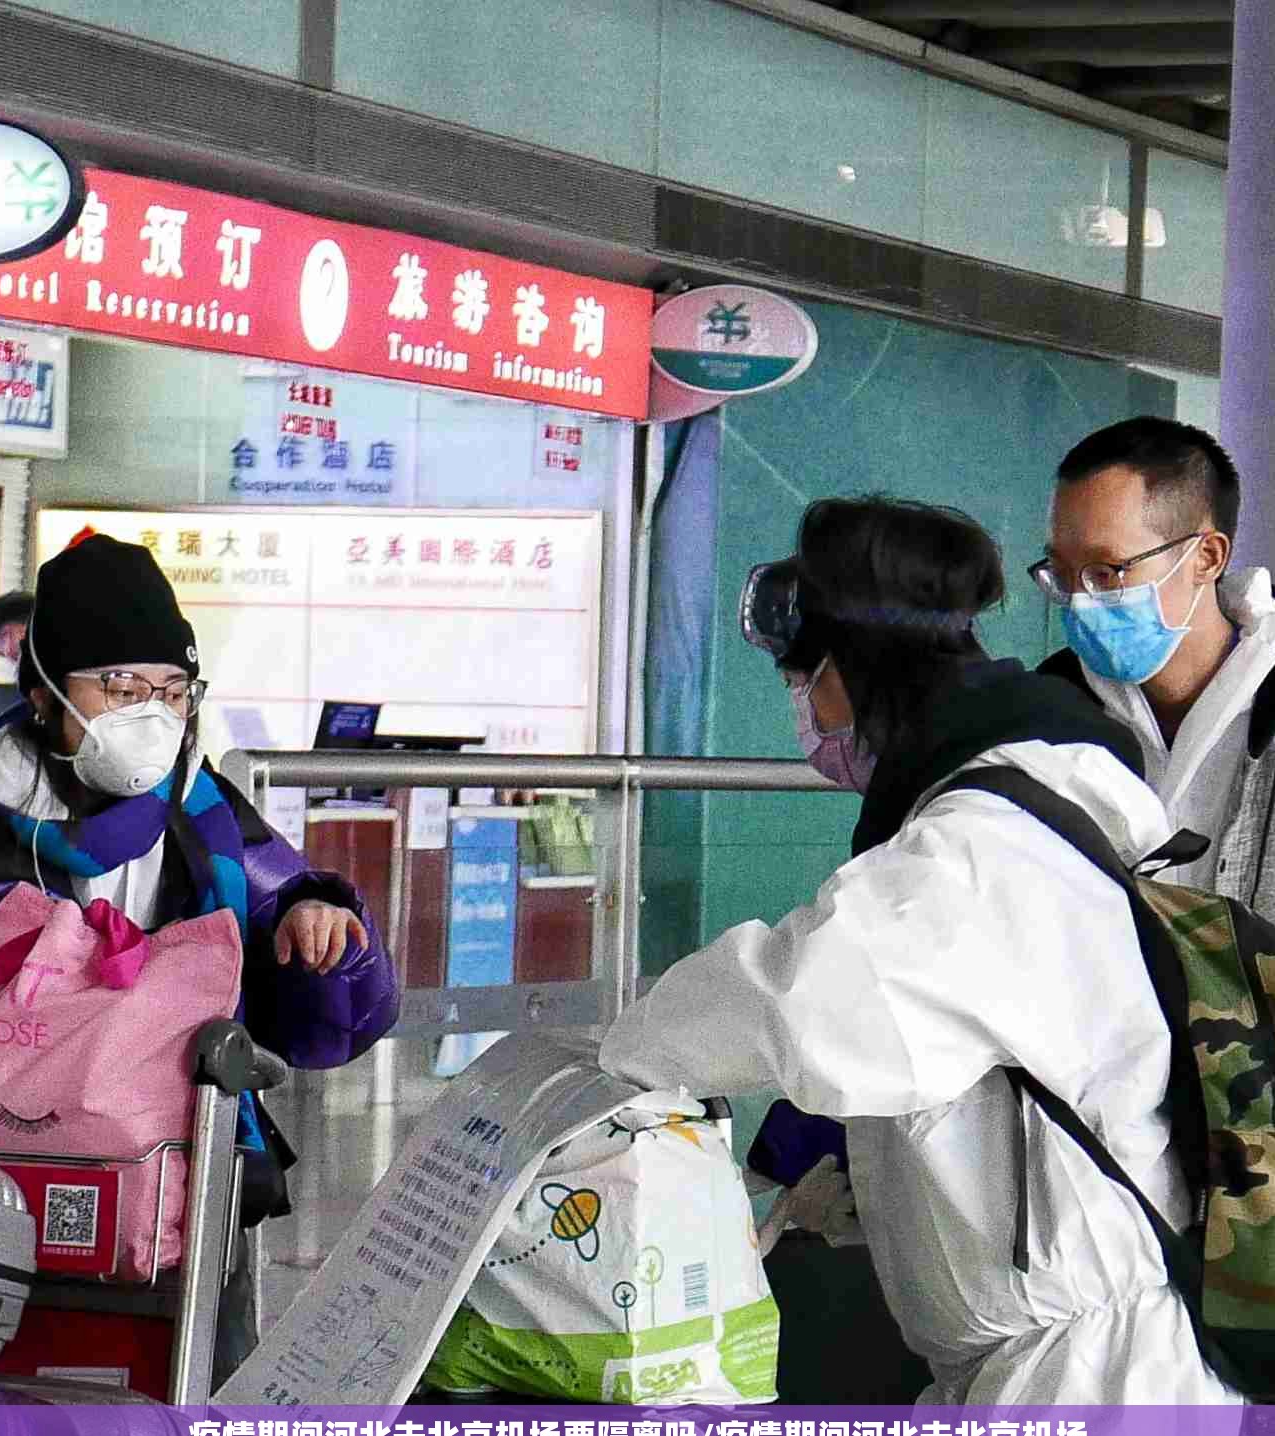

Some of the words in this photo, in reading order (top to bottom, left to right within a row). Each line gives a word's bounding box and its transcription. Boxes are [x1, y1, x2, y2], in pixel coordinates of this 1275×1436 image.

[86, 279, 250, 336] Reservation
[388, 252, 606, 360] 旅游咨询
[387, 332, 469, 372] Tourism
[493, 351, 604, 396] information
[231, 438, 396, 469] 合作酒店
